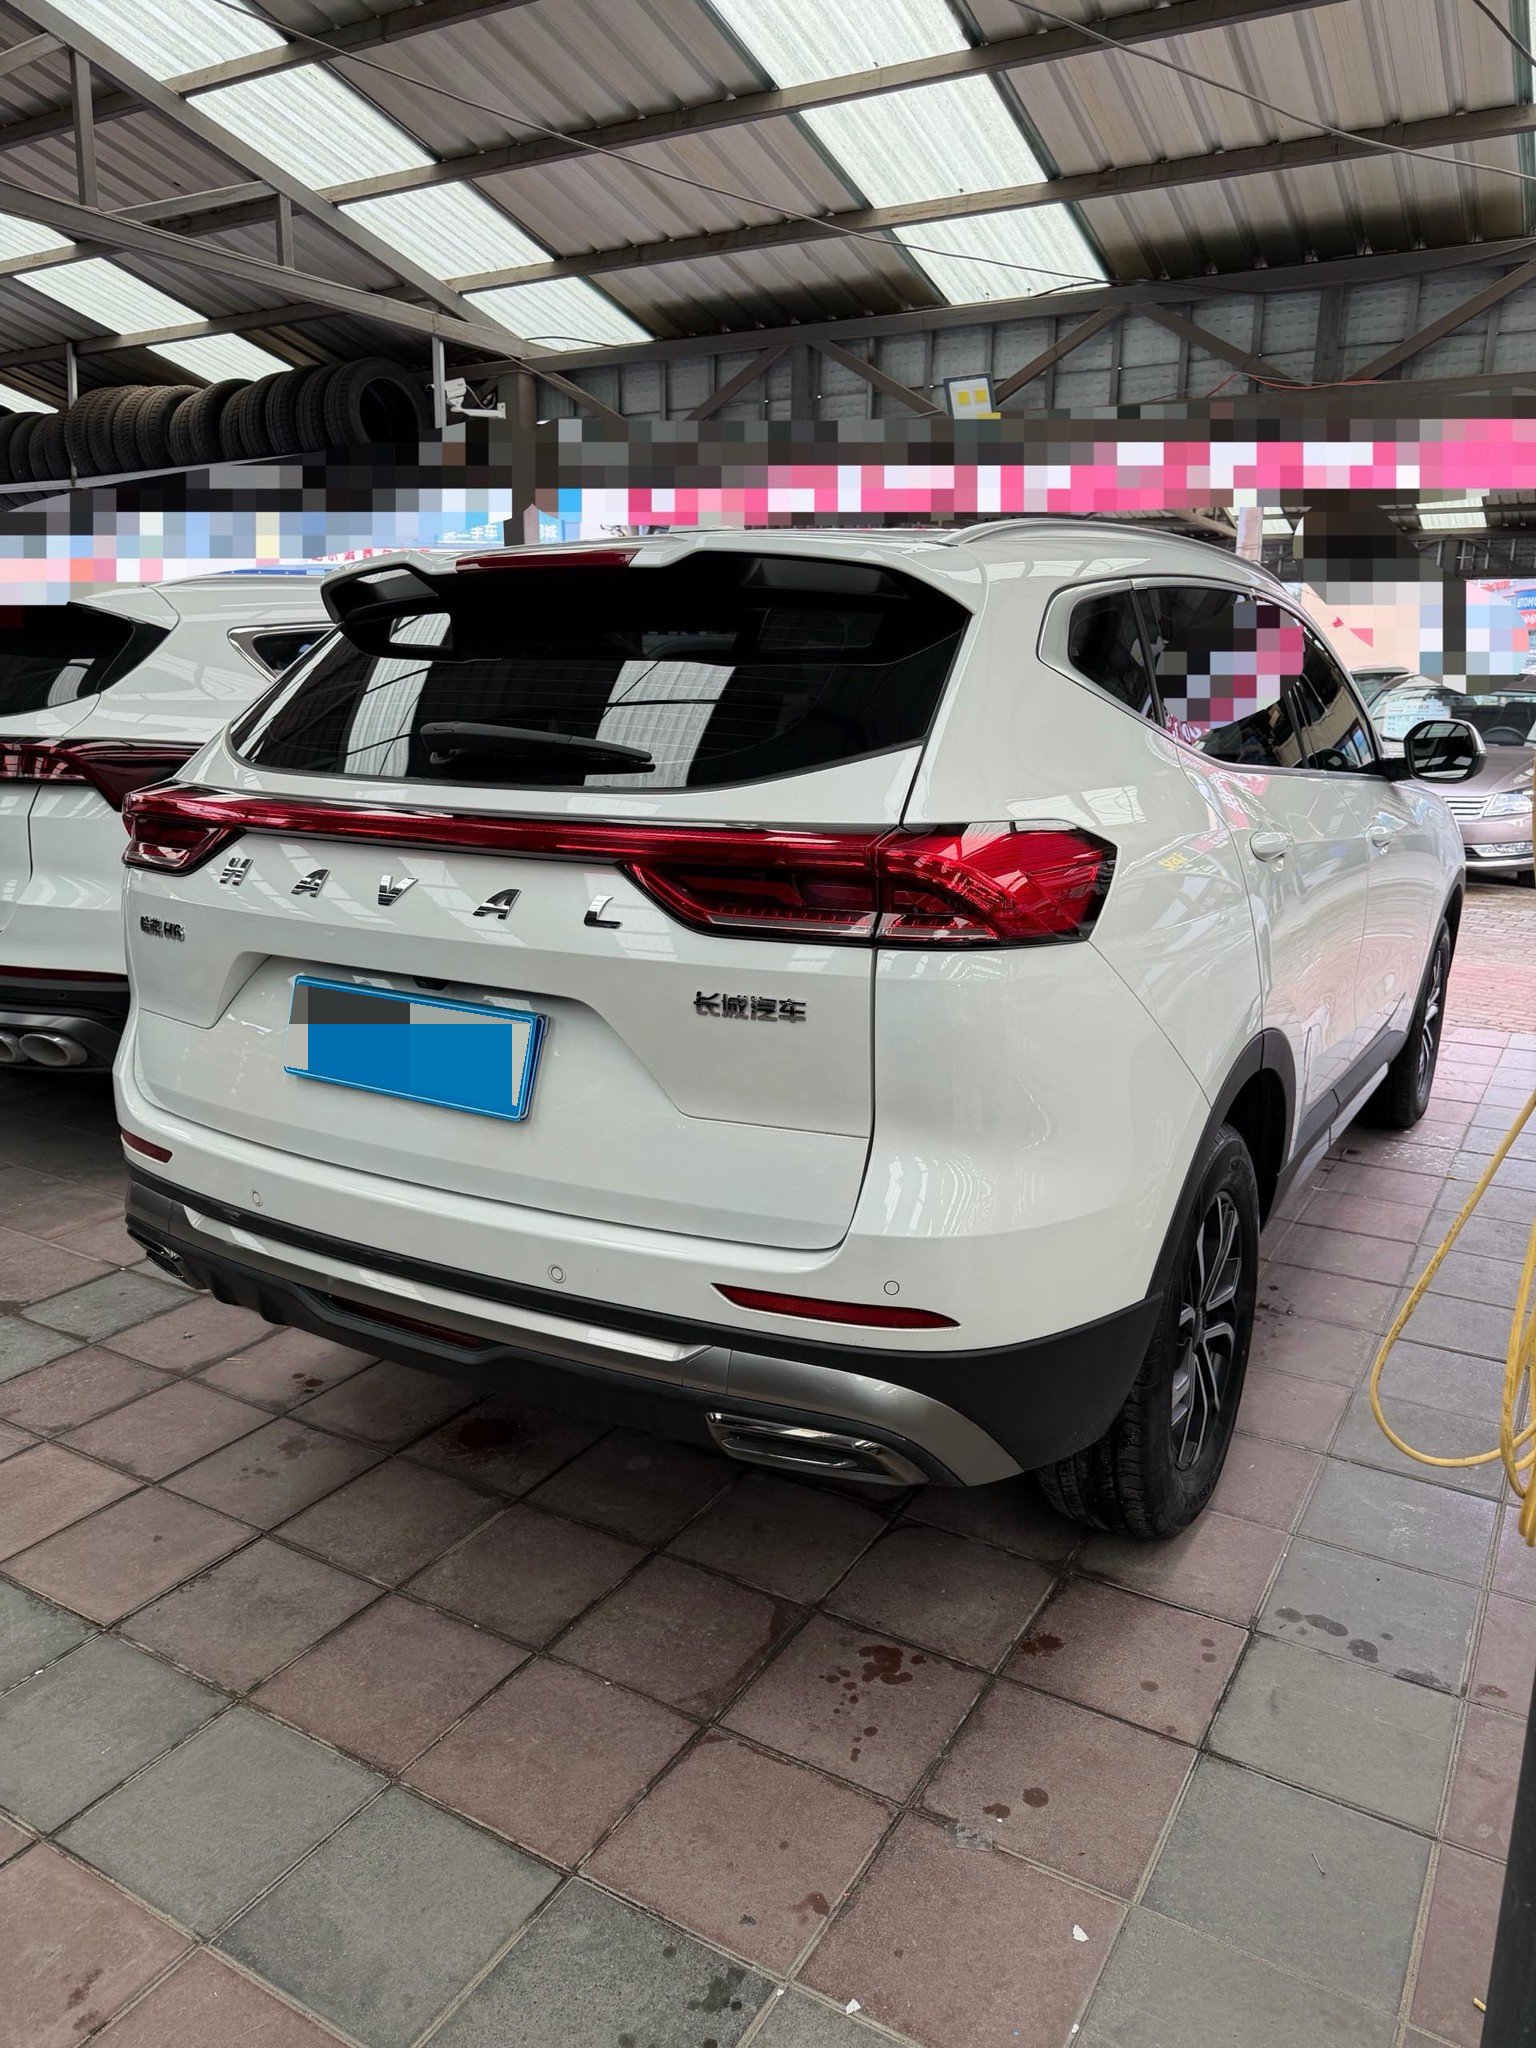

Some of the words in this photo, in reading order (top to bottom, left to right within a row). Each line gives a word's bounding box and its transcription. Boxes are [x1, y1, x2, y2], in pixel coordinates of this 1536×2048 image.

[218, 856, 623, 930] HAVAL
[693, 990, 807, 1024] 长城汽车
